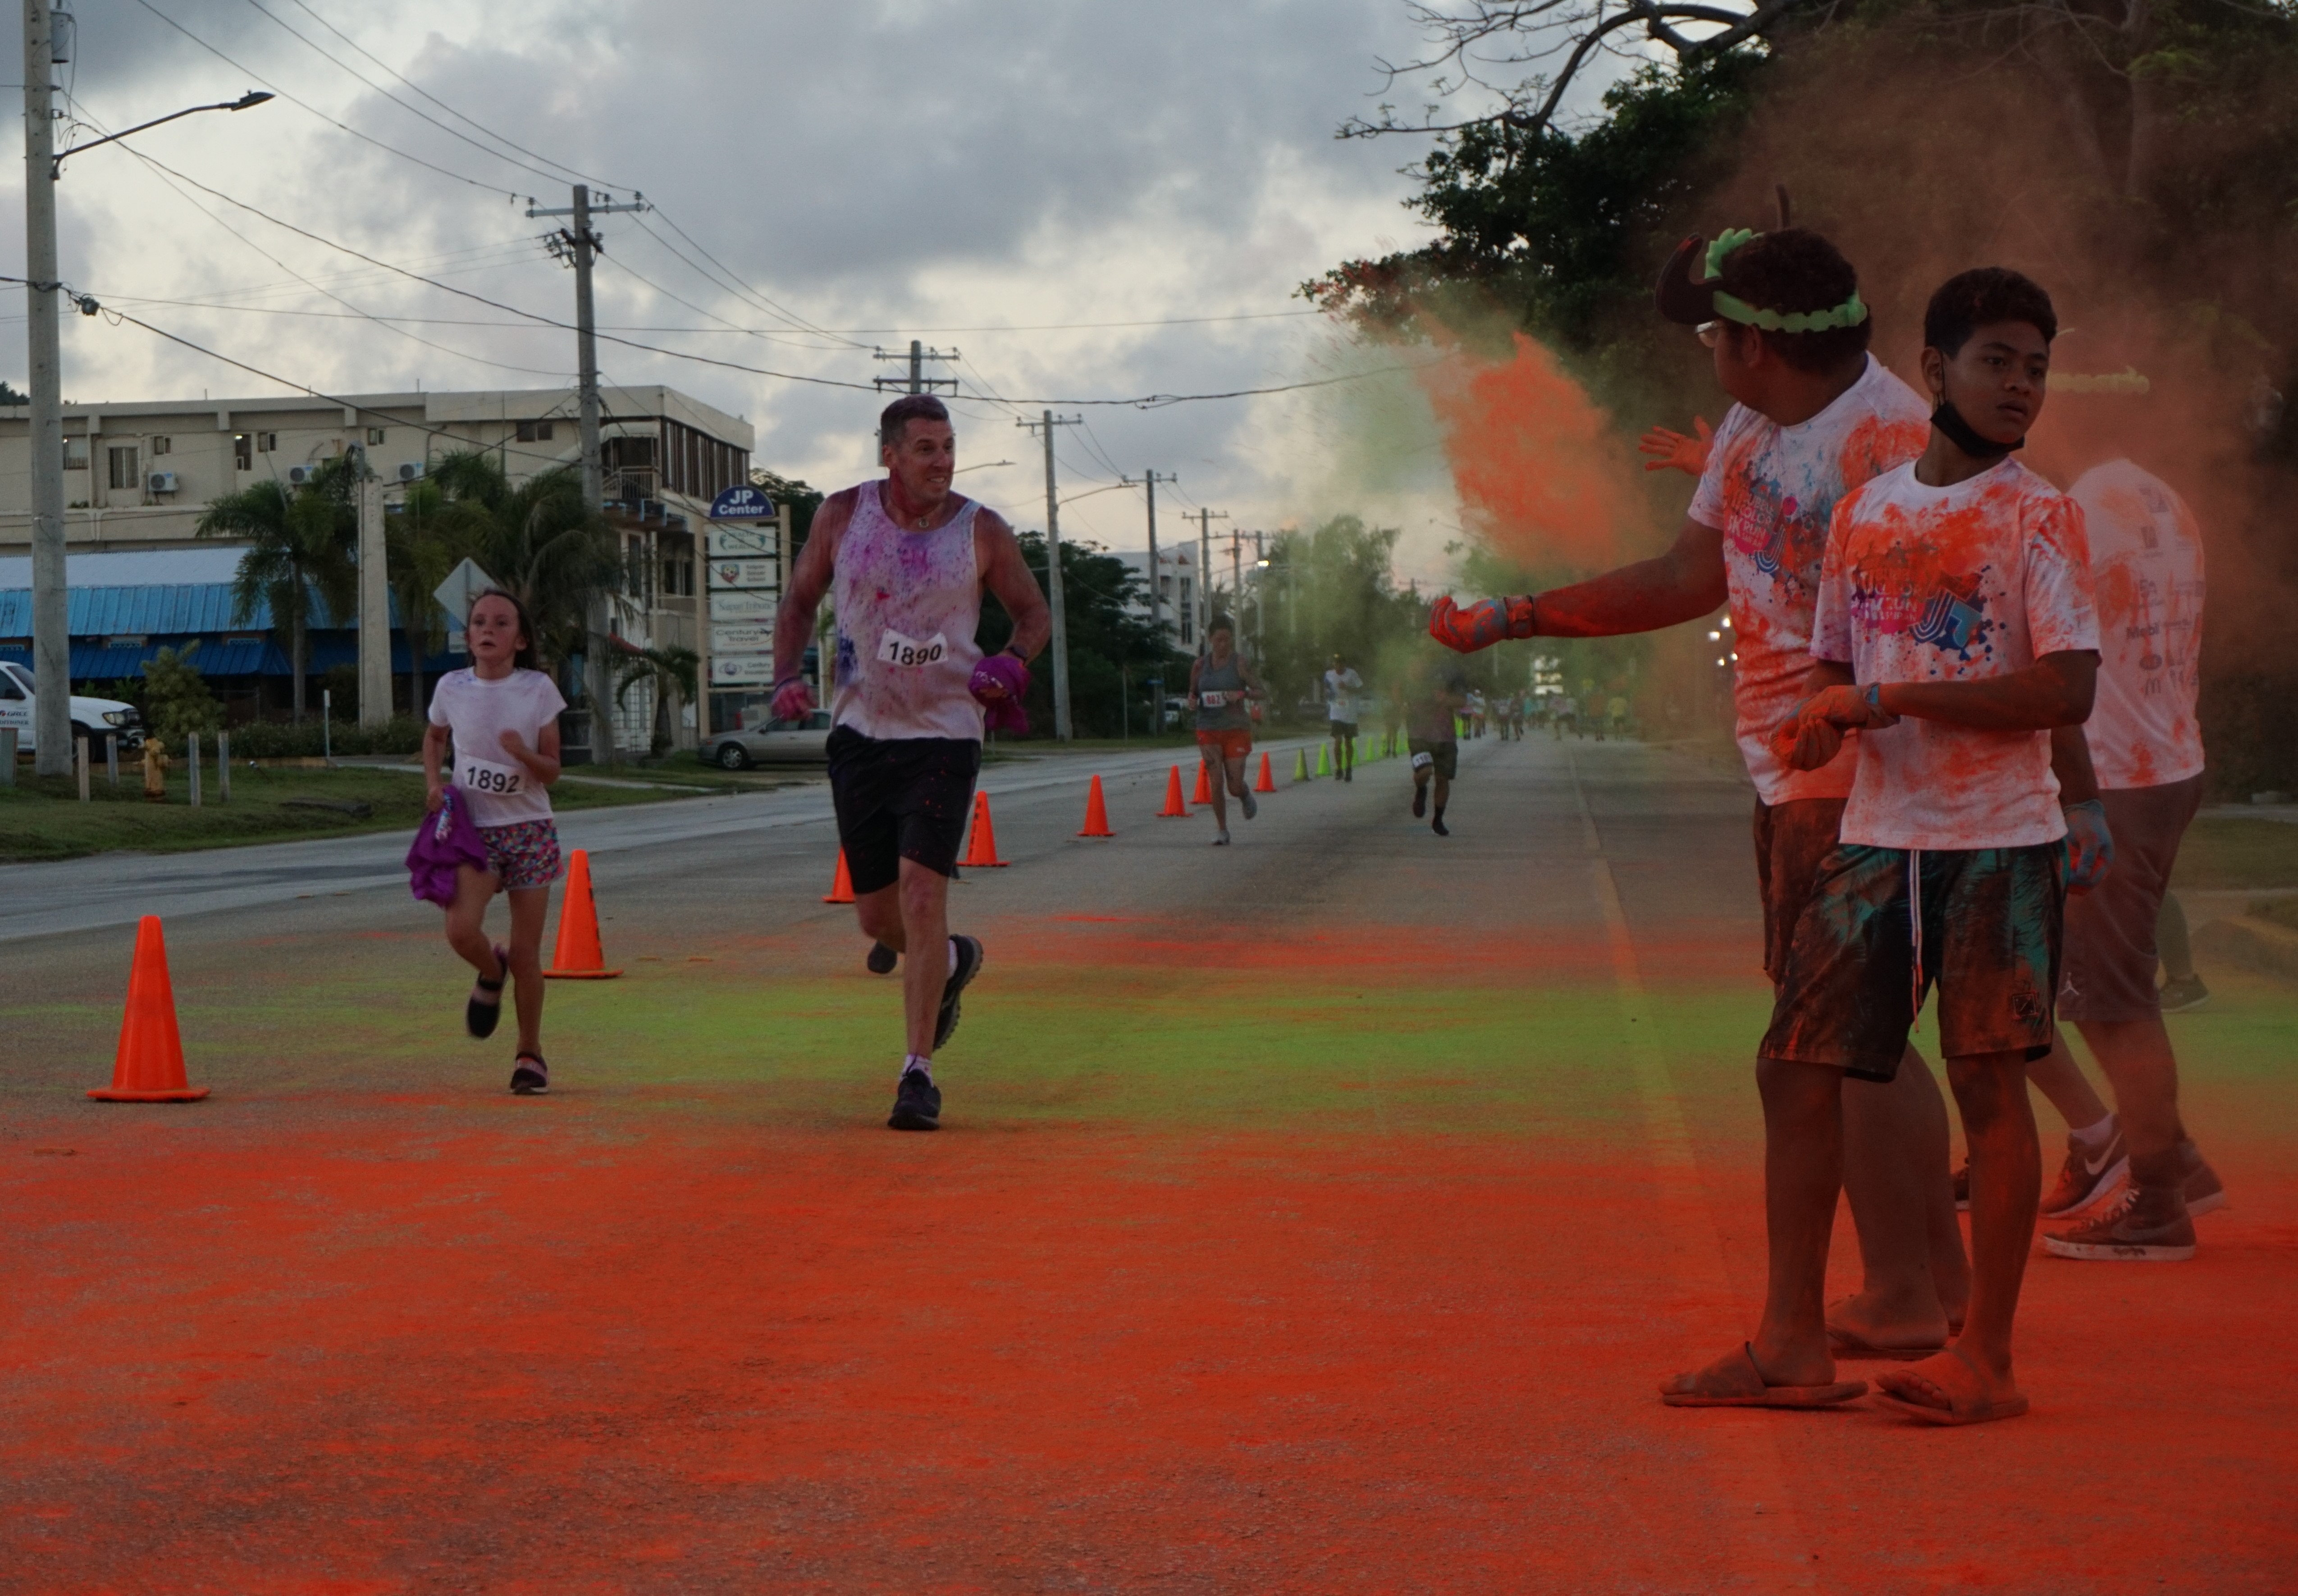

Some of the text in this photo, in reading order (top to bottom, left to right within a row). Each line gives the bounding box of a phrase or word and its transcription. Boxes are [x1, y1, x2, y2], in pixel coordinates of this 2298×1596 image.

[729, 490, 753, 504] JP
[718, 504, 765, 515] Center
[889, 641, 942, 665] 1890
[468, 766, 520, 793] 1892
